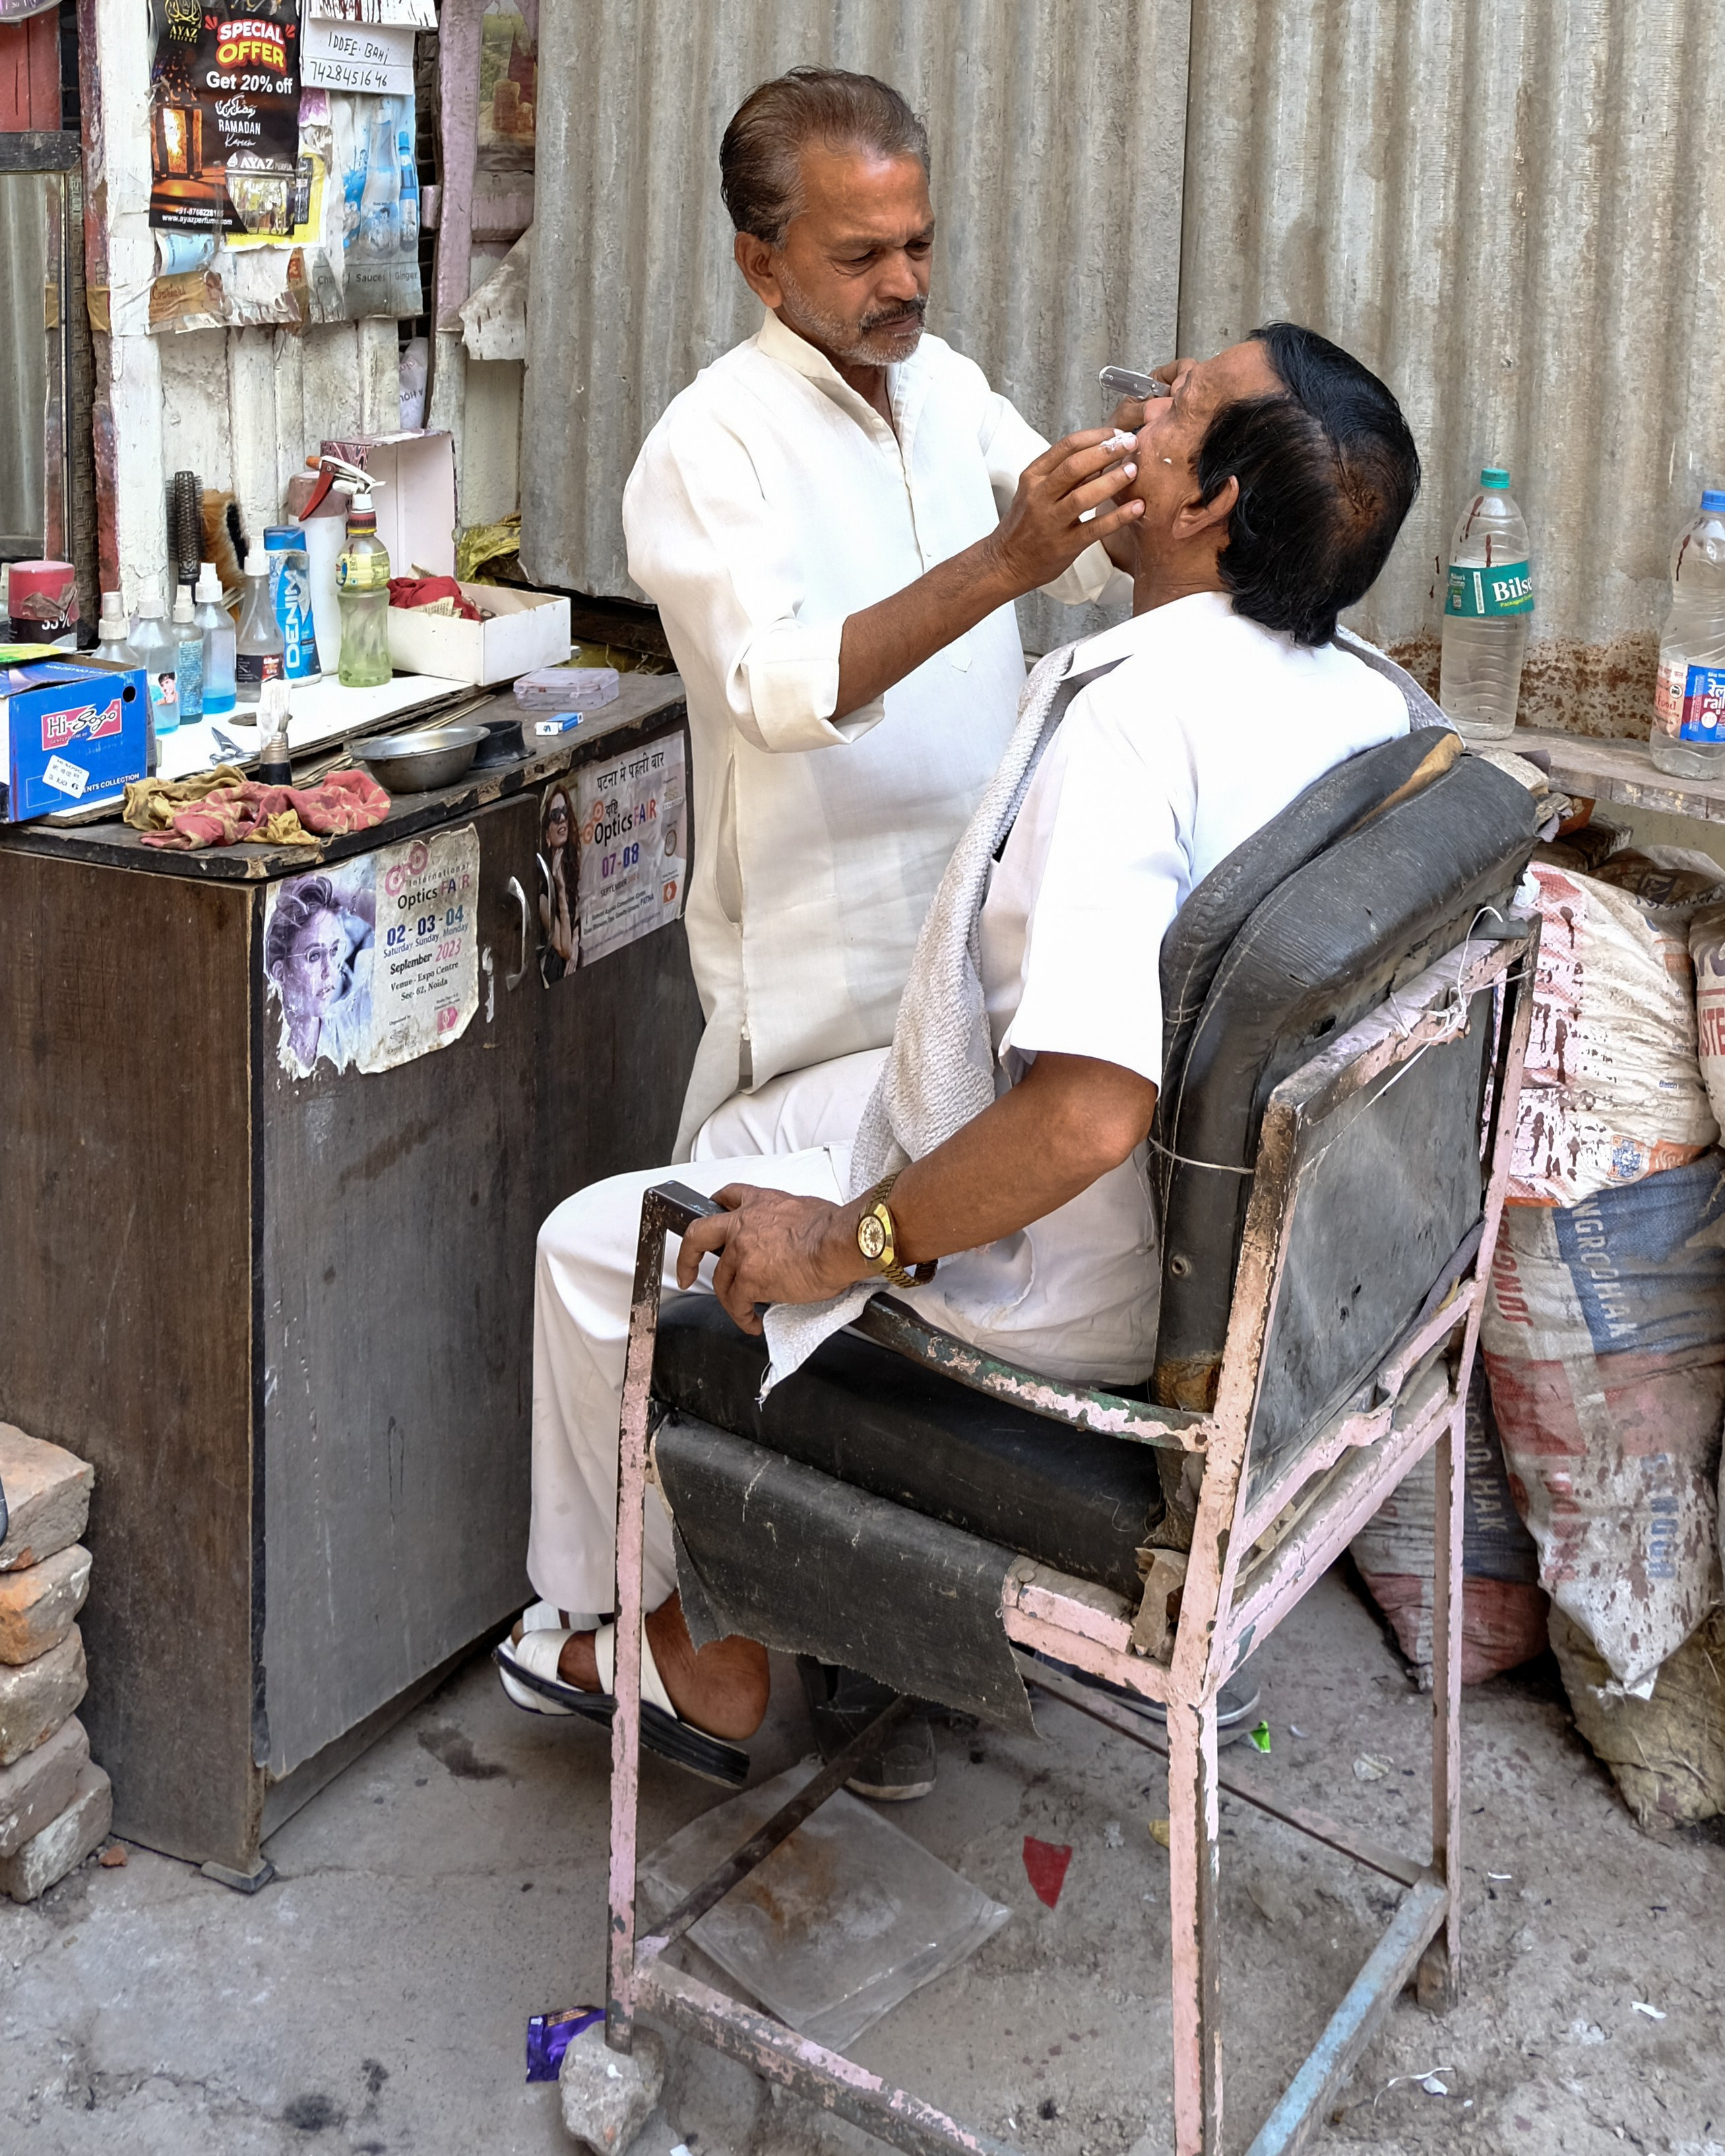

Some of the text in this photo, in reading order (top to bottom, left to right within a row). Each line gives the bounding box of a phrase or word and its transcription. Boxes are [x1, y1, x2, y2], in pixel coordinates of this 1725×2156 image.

[169, 25, 198, 38] AYAZ
[219, 21, 284, 45] SPECIAL
[218, 40, 284, 68] OFFER
[206, 71, 293, 94] Get 20% off
[218, 119, 261, 135] RAMADAN
[240, 157, 274, 170] AYAZ
[356, 272, 386, 283] Sauces
[395, 272, 417, 281] Ginger
[284, 570, 301, 668] DENIM
[49, 709, 117, 737] Hi-Sogo
[83, 773, 139, 794] ENTS COLLECTION
[597, 770, 619, 792] पटना
[629, 752, 650, 780] पहली
[651, 751, 665, 769] बार
[594, 813, 633, 847] Optics
[408, 862, 470, 887] International
[398, 887, 439, 911] Optics
[387, 924, 406, 947] 02
[417, 914, 436, 937] 03
[445, 903, 464, 926] 04
[383, 922, 469, 959] Saturday Sunday Monday
[390, 937, 462, 976] September 2023
[390, 979, 413, 992] Venue
[417, 970, 435, 982] Expo
[436, 961, 460, 975] Centre
[428, 977, 449, 992] Noida
